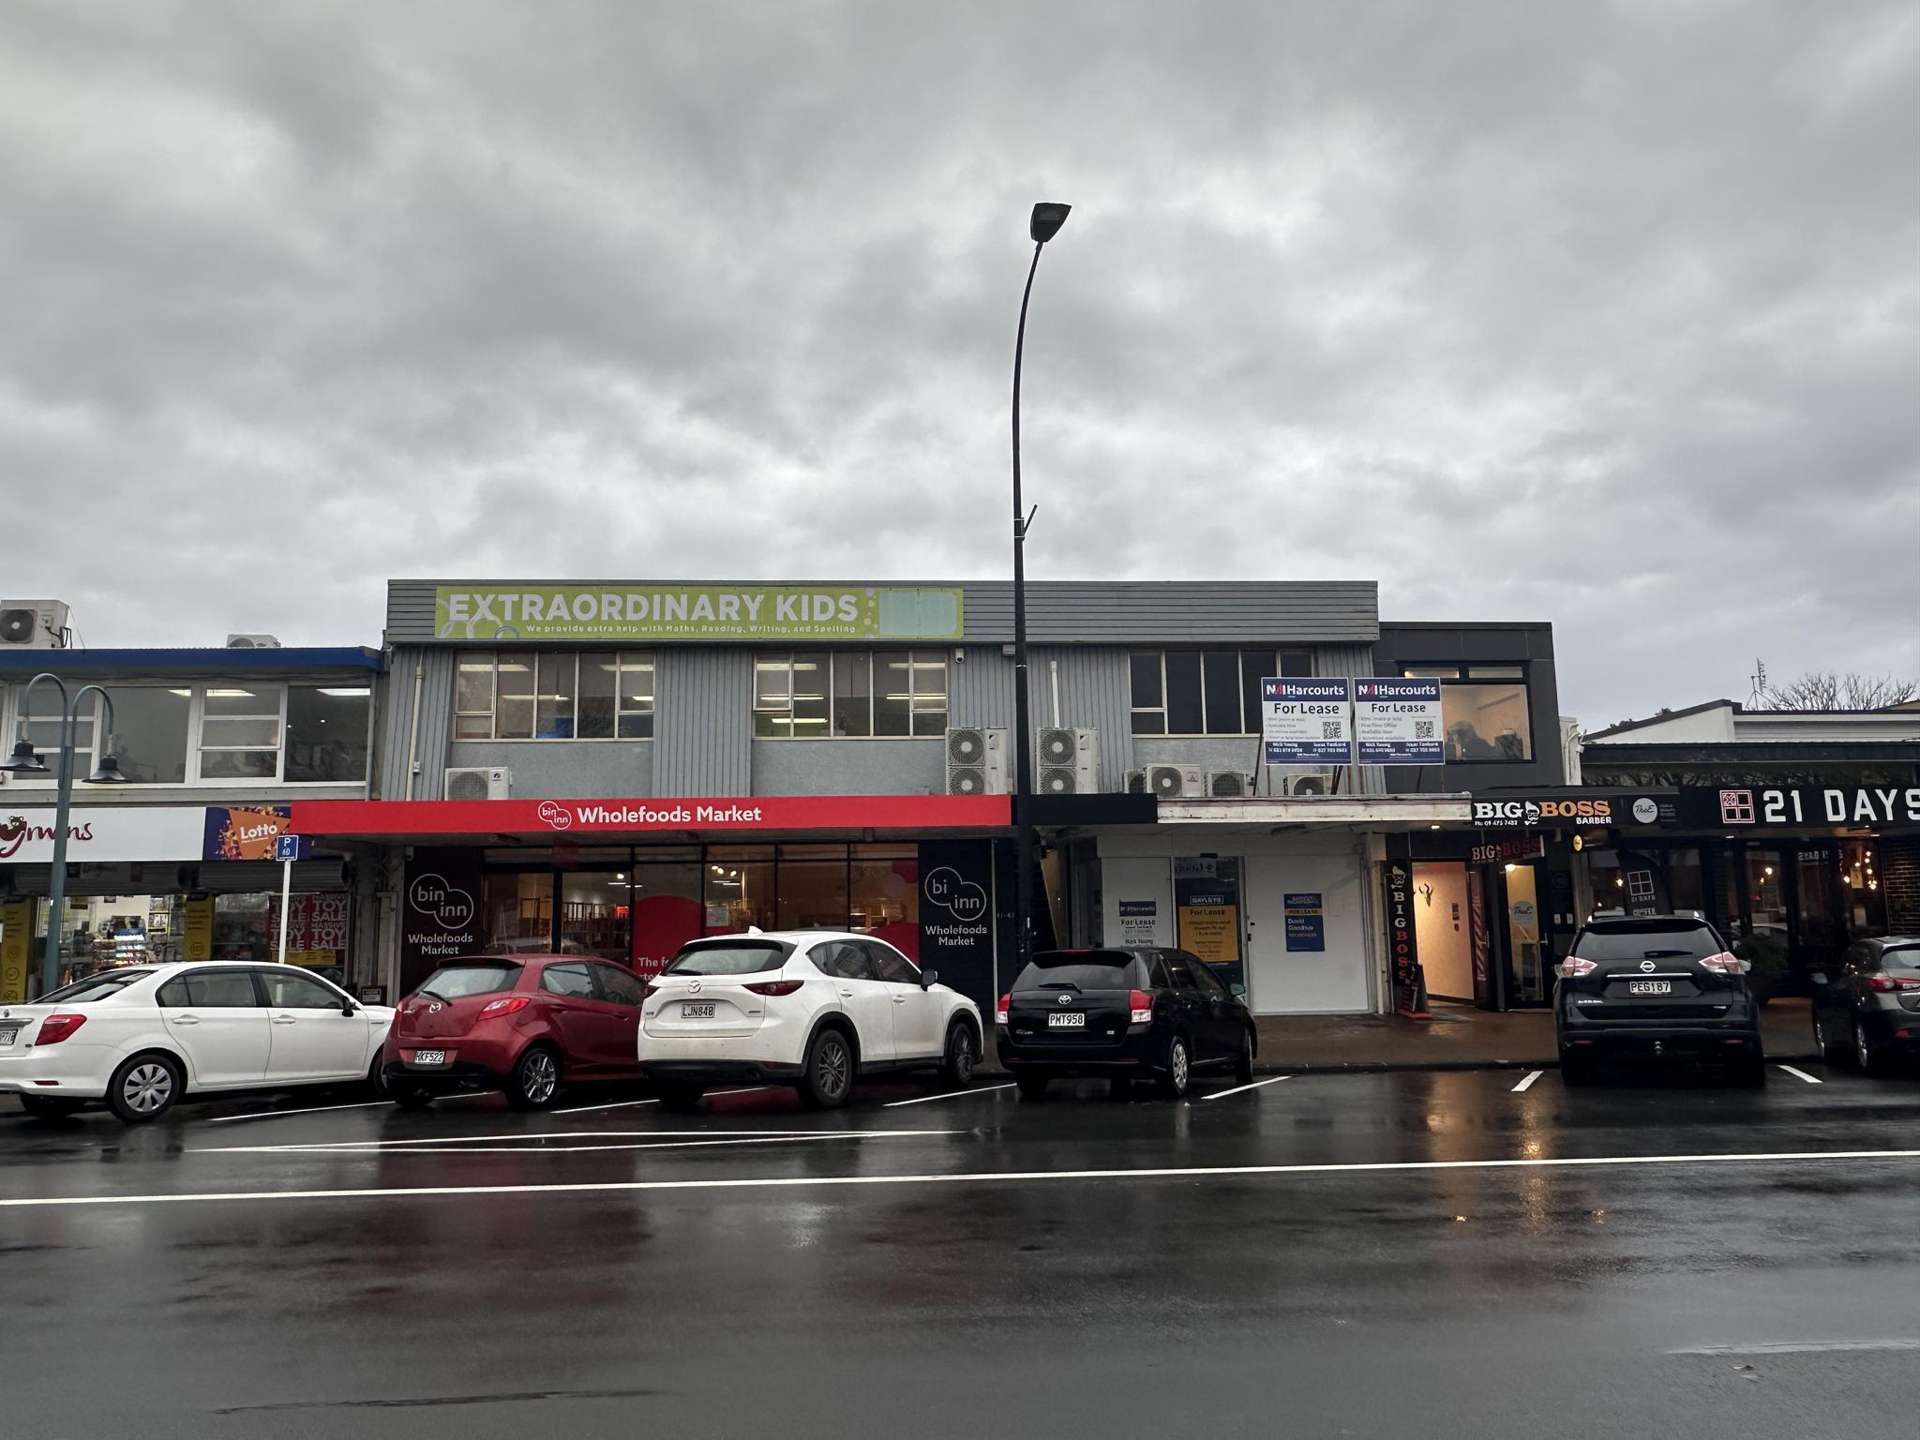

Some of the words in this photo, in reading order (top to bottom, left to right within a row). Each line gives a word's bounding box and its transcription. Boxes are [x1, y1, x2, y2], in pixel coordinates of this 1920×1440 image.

[449, 593, 765, 622] EXTRAORDINARY
[776, 594, 858, 622] KIDS
[526, 624, 541, 634] We
[544, 624, 583, 634] provide
[587, 624, 613, 634] extra
[616, 624, 638, 634] help
[641, 624, 662, 634] with
[794, 624, 810, 634] and
[814, 624, 856, 635] Spelling
[1287, 684, 1345, 695] Harcourts
[1379, 684, 1436, 695] Harcourts
[1274, 703, 1297, 714] For
[1300, 702, 1340, 714] Lease
[1371, 703, 1390, 713] For
[1393, 702, 1426, 713] Lease
[1473, 802, 1524, 819] BIG
[1539, 800, 1611, 817] BOSS
[1762, 789, 1803, 822] 21
[1823, 788, 1920, 822] DAYS
[542, 806, 557, 816] bin
[577, 806, 691, 824] Wholefoods
[696, 805, 762, 822] Market
[553, 814, 569, 823] inn
[1576, 816, 1612, 825] BARBER
[240, 823, 278, 840] Lotto
[283, 837, 291, 847] P
[1472, 844, 1495, 861] BIG
[417, 886, 445, 902] bin
[313, 900, 346, 913] TOY
[954, 894, 980, 909] inn
[439, 901, 468, 917] inn
[1190, 908, 1203, 916] For
[1204, 907, 1226, 916] Lease
[271, 912, 306, 922] SLE
[311, 911, 347, 922] SALE
[311, 928, 346, 941] TOY
[925, 924, 988, 936] Wholefoods
[407, 932, 474, 945] Wholefoods
[938, 935, 975, 946] Market
[270, 940, 305, 951] SLE
[310, 940, 346, 951] SALE
[421, 944, 460, 955] Market
[638, 956, 659, 967] The
[1630, 981, 1669, 992] PEG187
[682, 1006, 714, 1017] LJN848
[1049, 1014, 1084, 1025] PMT958
